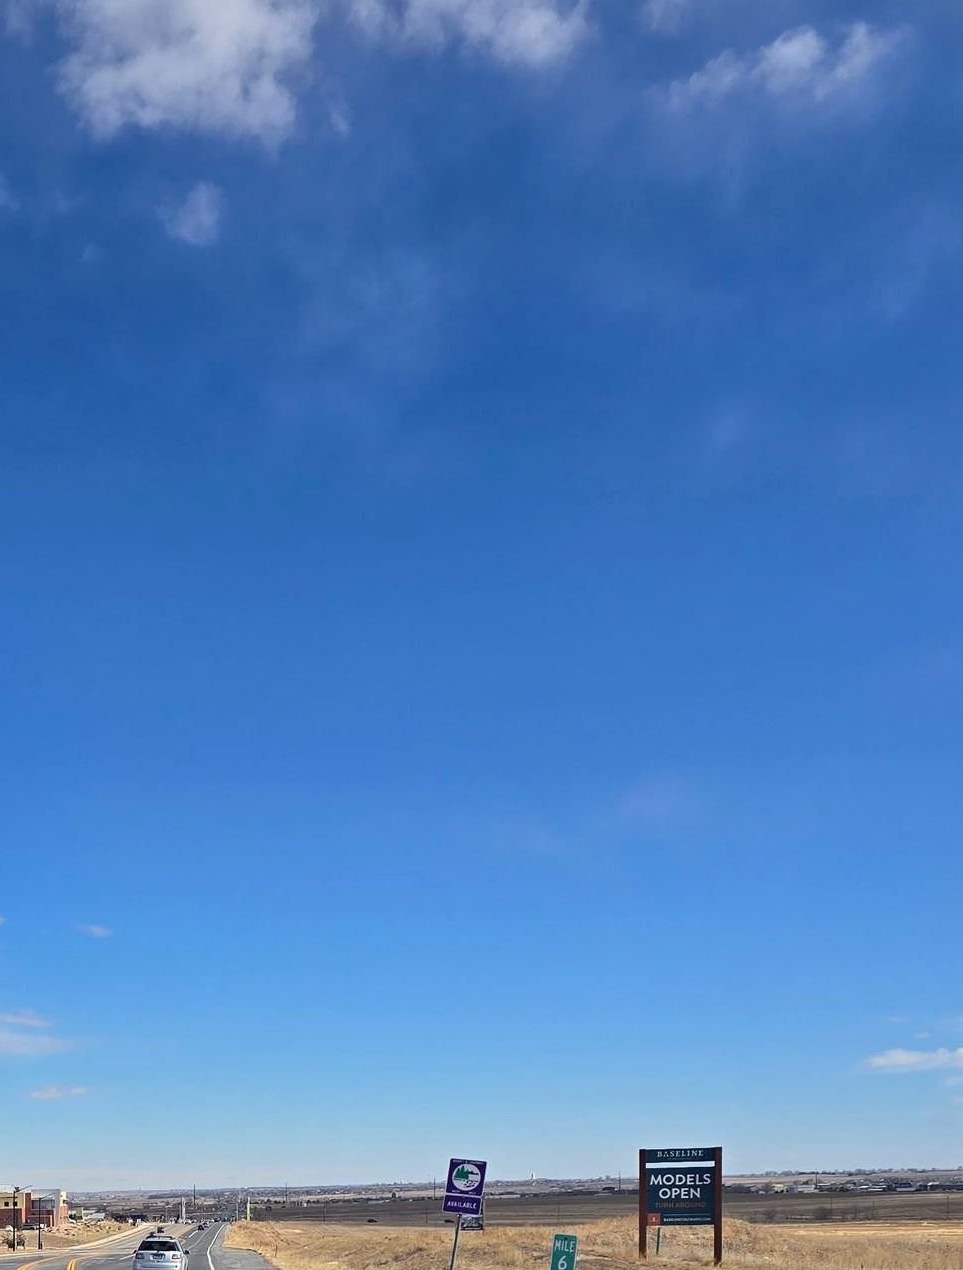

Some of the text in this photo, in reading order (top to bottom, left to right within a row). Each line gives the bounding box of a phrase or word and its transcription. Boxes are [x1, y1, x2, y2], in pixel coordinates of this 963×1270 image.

[657, 1149, 704, 1157] BASELINE
[649, 1173, 711, 1186] MODELS
[658, 1187, 701, 1199] OPEN
[446, 1200, 477, 1209] AVAILABLE
[554, 1240, 575, 1252] MILE
